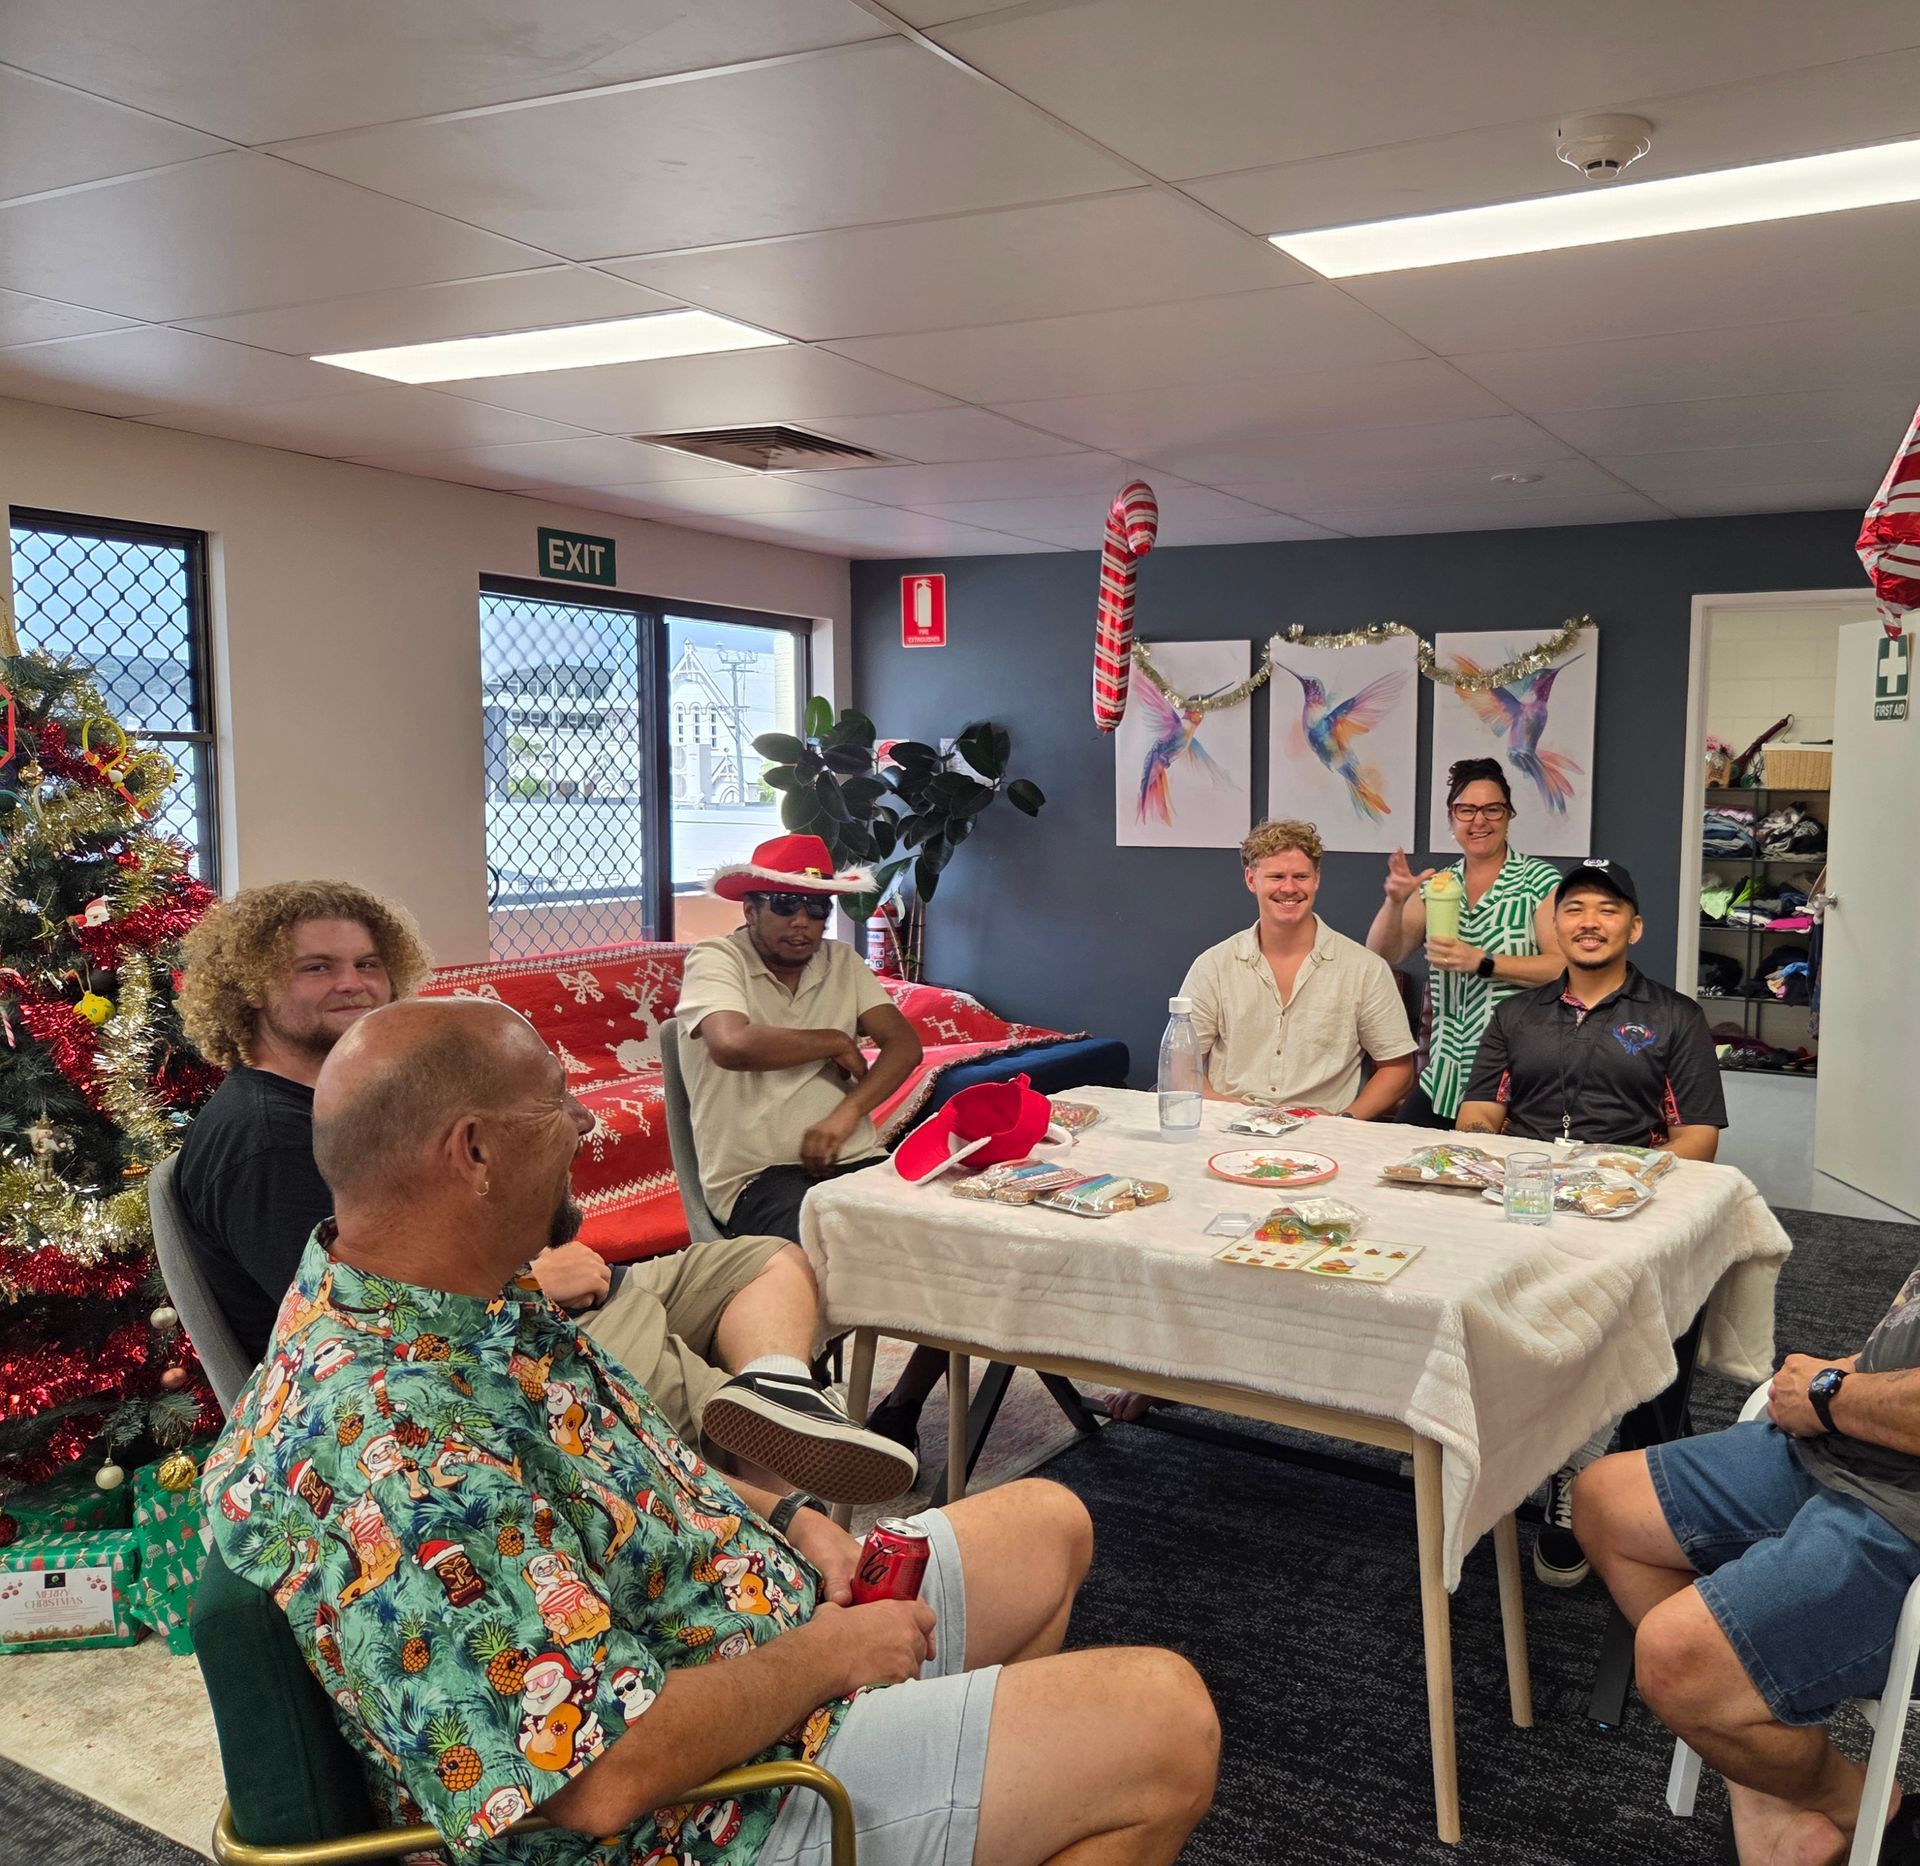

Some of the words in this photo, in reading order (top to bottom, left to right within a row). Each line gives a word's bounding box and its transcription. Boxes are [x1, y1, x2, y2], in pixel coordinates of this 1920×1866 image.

[548, 538, 605, 576] EXIT
[1875, 704, 1893, 717] FIRST
[1893, 703, 1905, 716] AID
[35, 1589, 69, 1599] MERRY
[24, 1596, 83, 1609] CHRISTMAS
